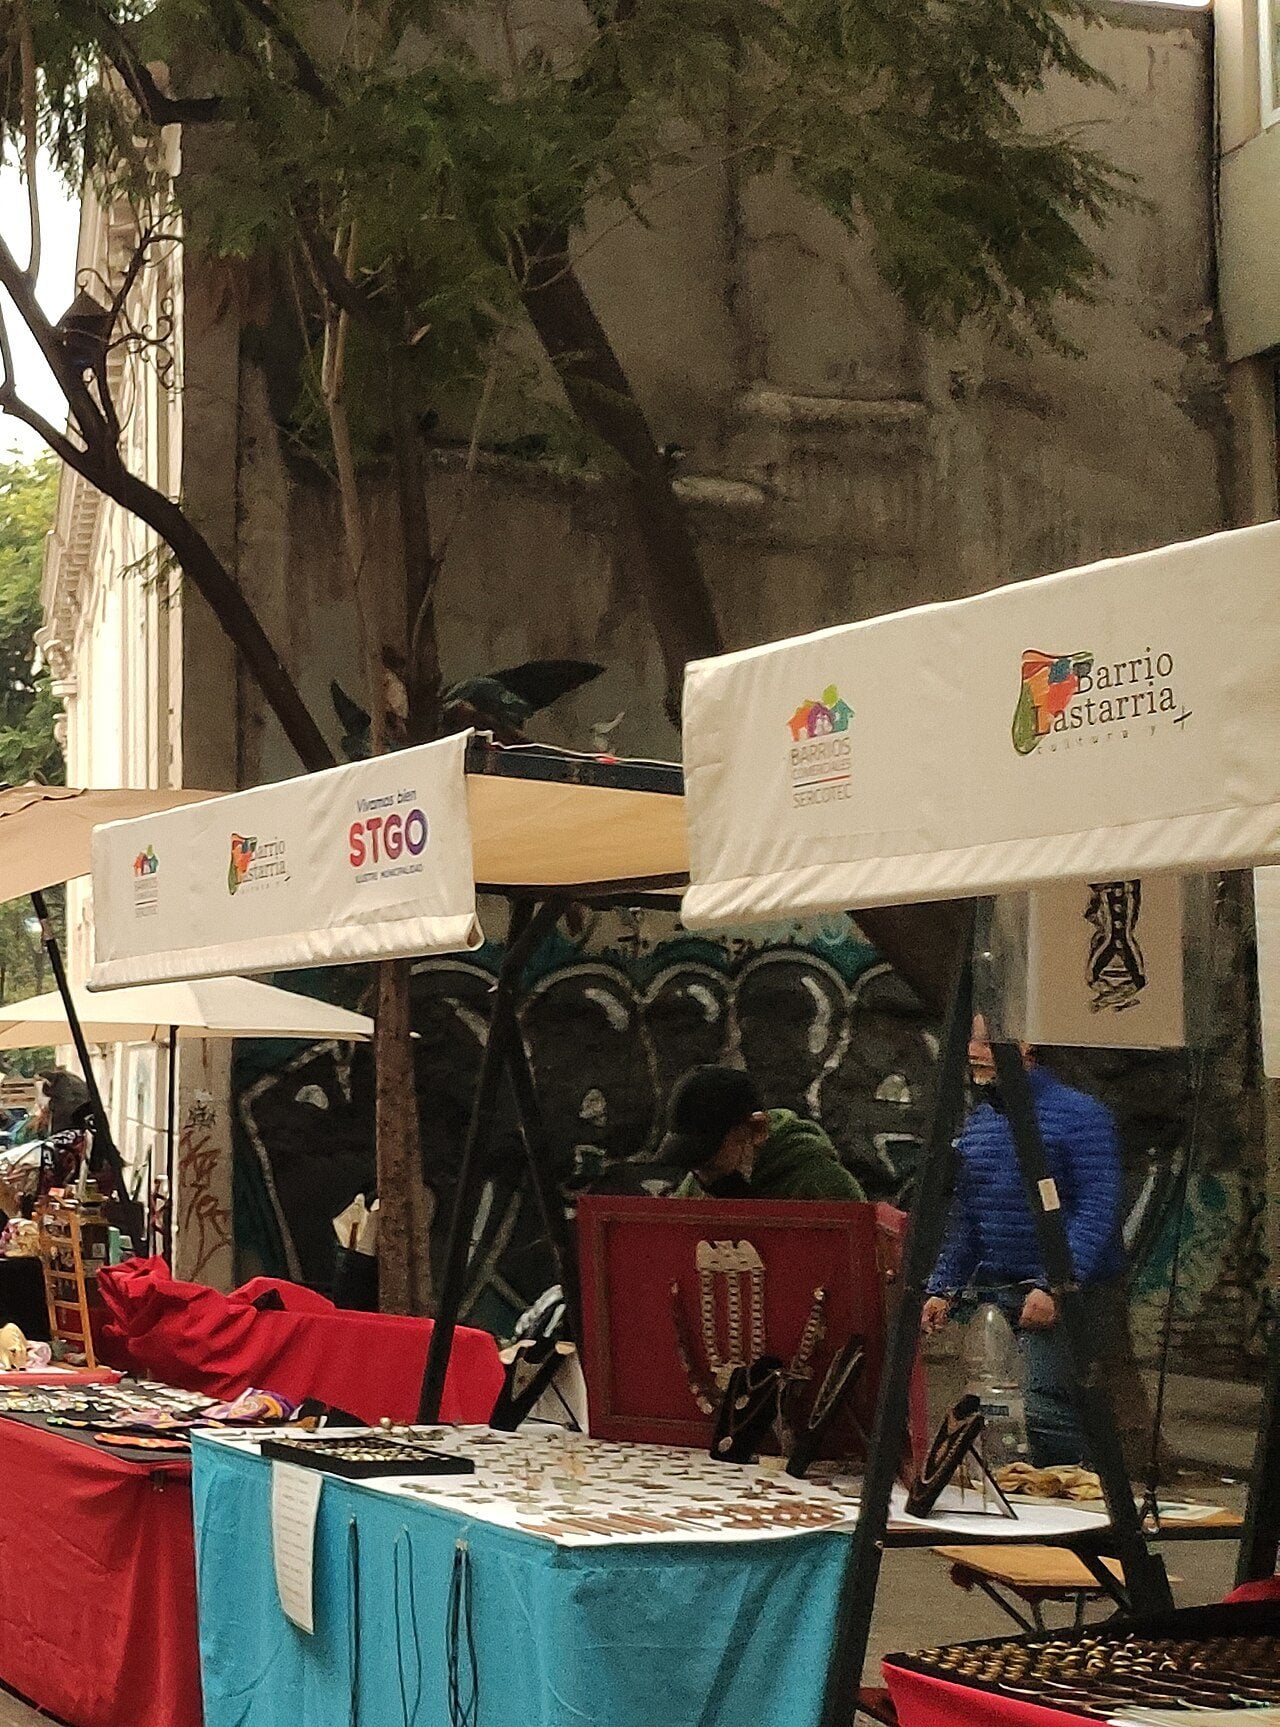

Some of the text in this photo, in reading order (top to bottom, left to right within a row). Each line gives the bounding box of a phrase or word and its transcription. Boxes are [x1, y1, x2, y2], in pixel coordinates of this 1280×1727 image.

[1072, 646, 1174, 696] Barrio
[1032, 681, 1177, 737] Lastarria
[790, 736, 851, 767] BARRIOS
[349, 809, 428, 868] STGO
